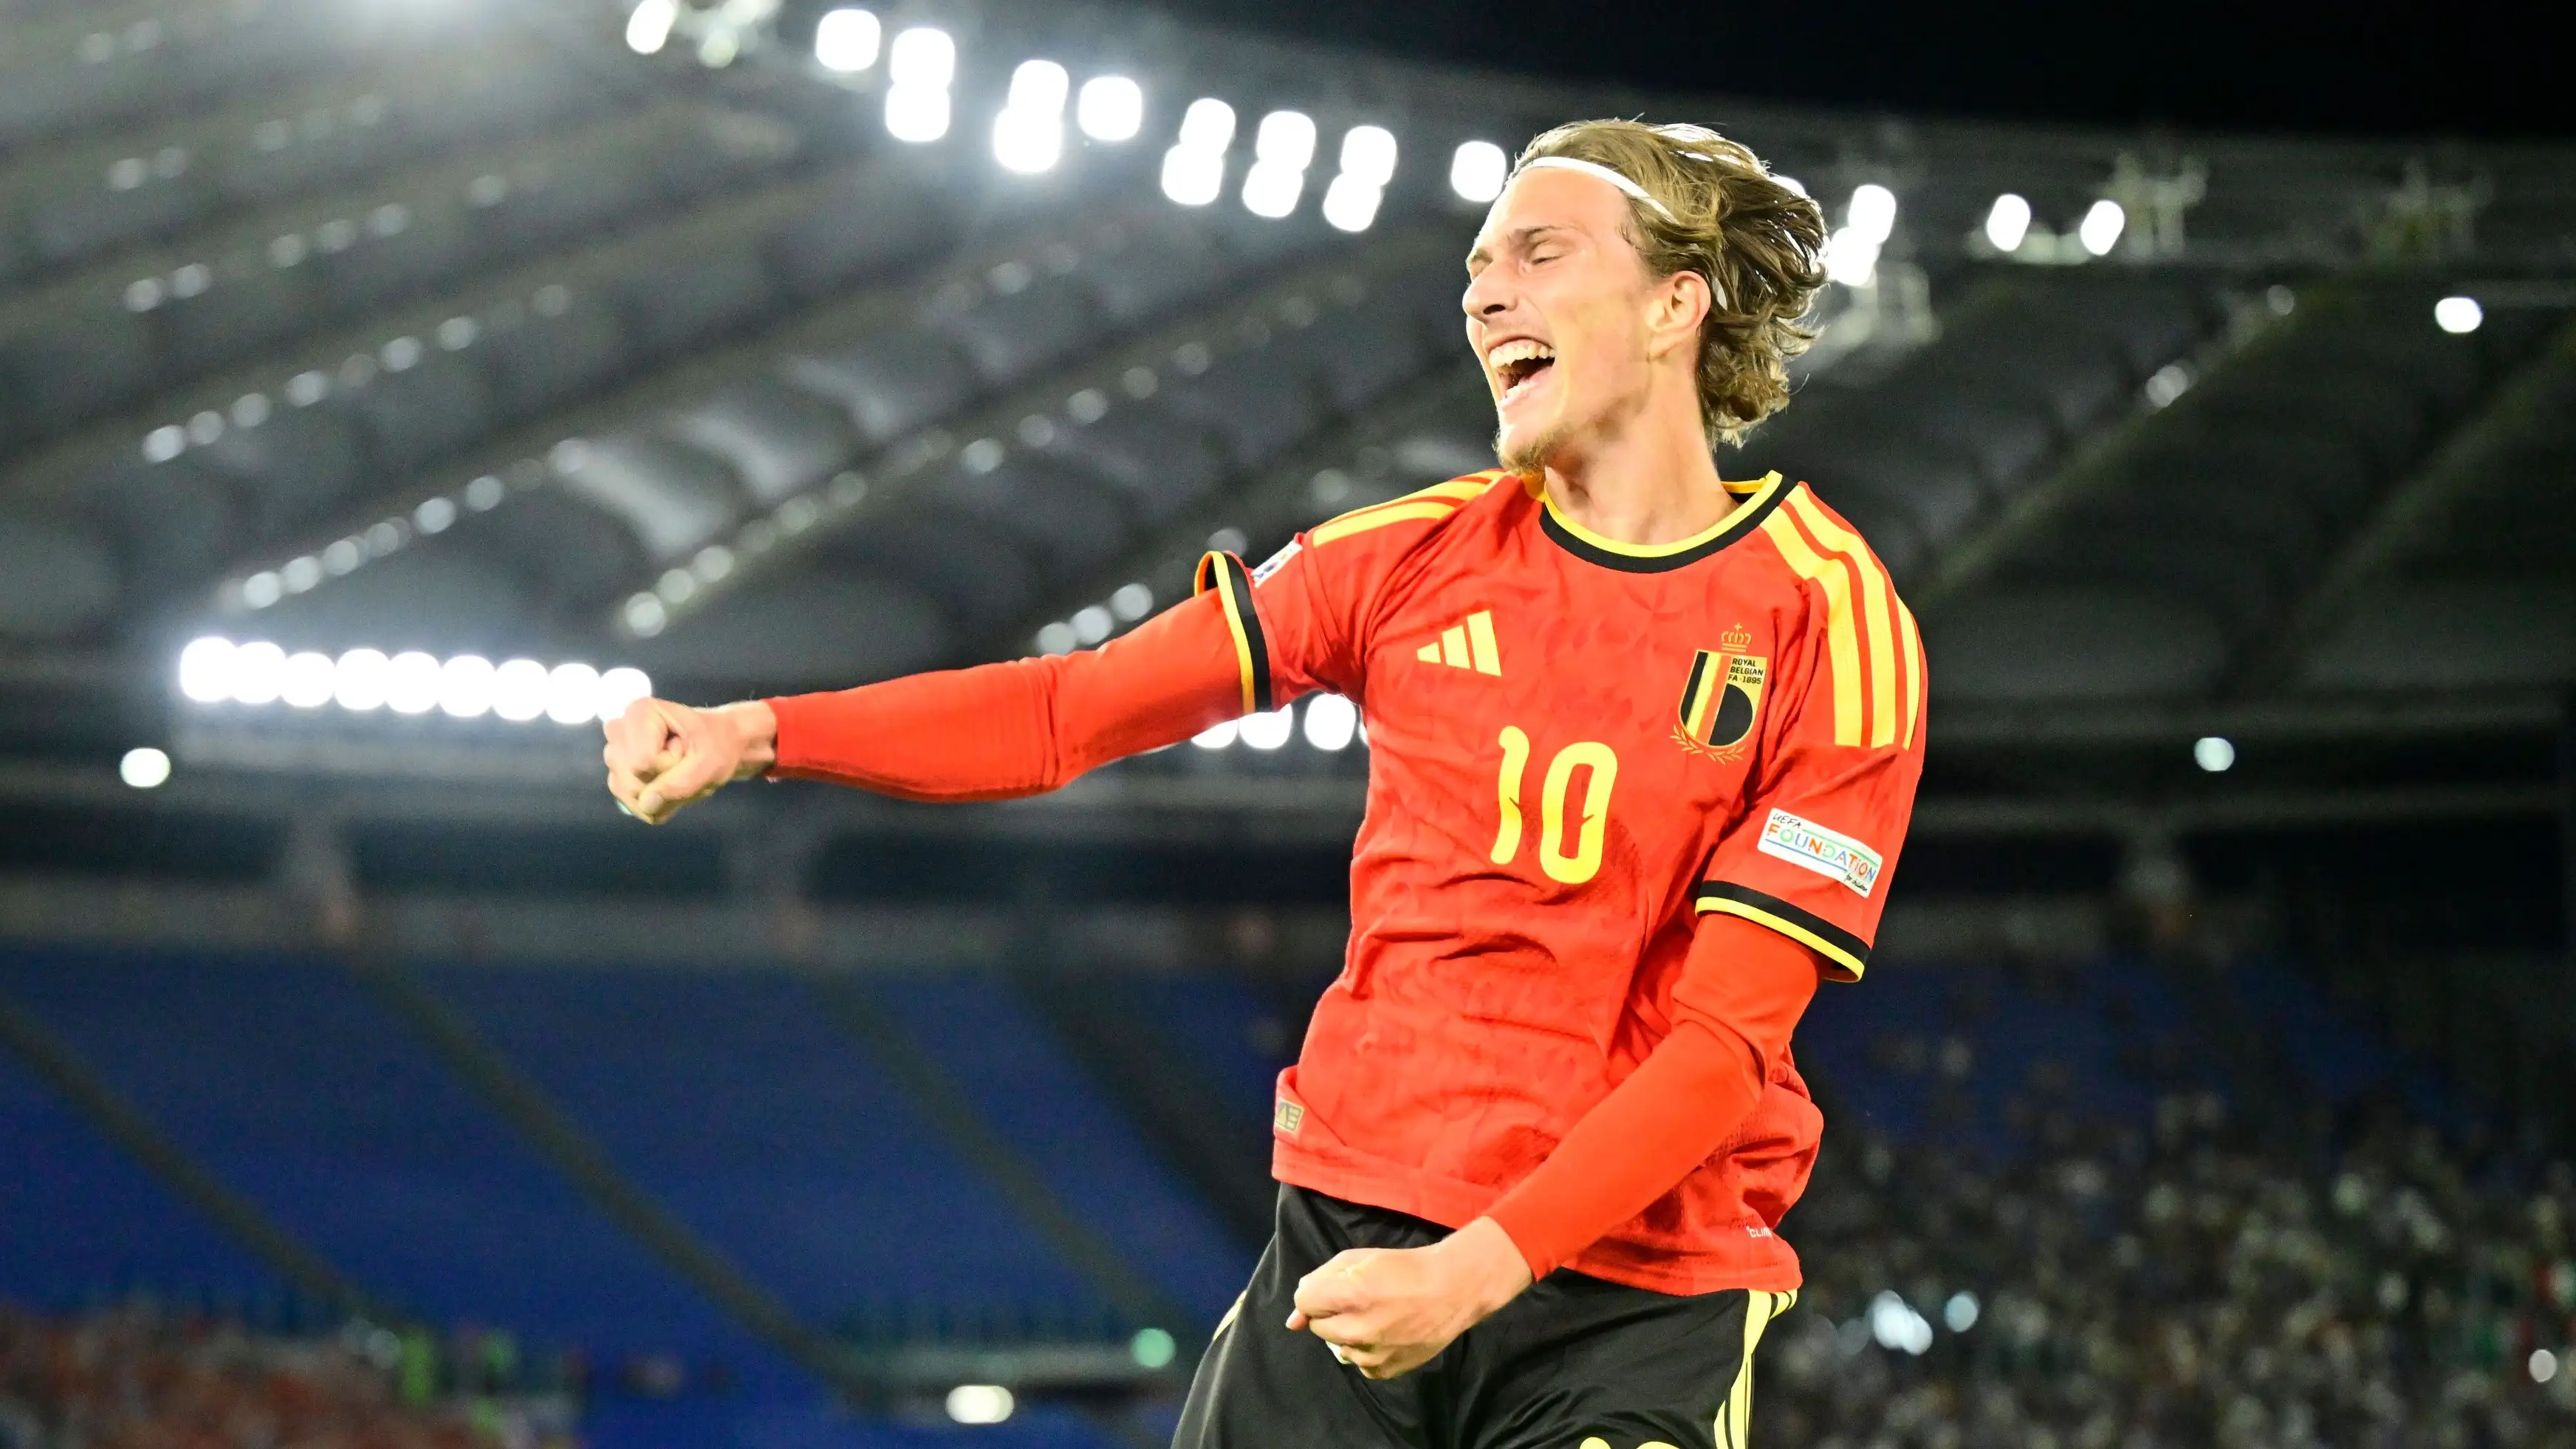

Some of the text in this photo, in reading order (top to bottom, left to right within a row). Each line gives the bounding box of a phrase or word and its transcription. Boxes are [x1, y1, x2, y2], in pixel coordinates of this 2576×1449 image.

[1732, 658, 1756, 667] ROYAL
[1730, 666, 1764, 676] BELGIAN
[1742, 676, 1762, 685] 1895
[1490, 725, 1618, 884] 10
[1772, 812, 1802, 829] UEFA
